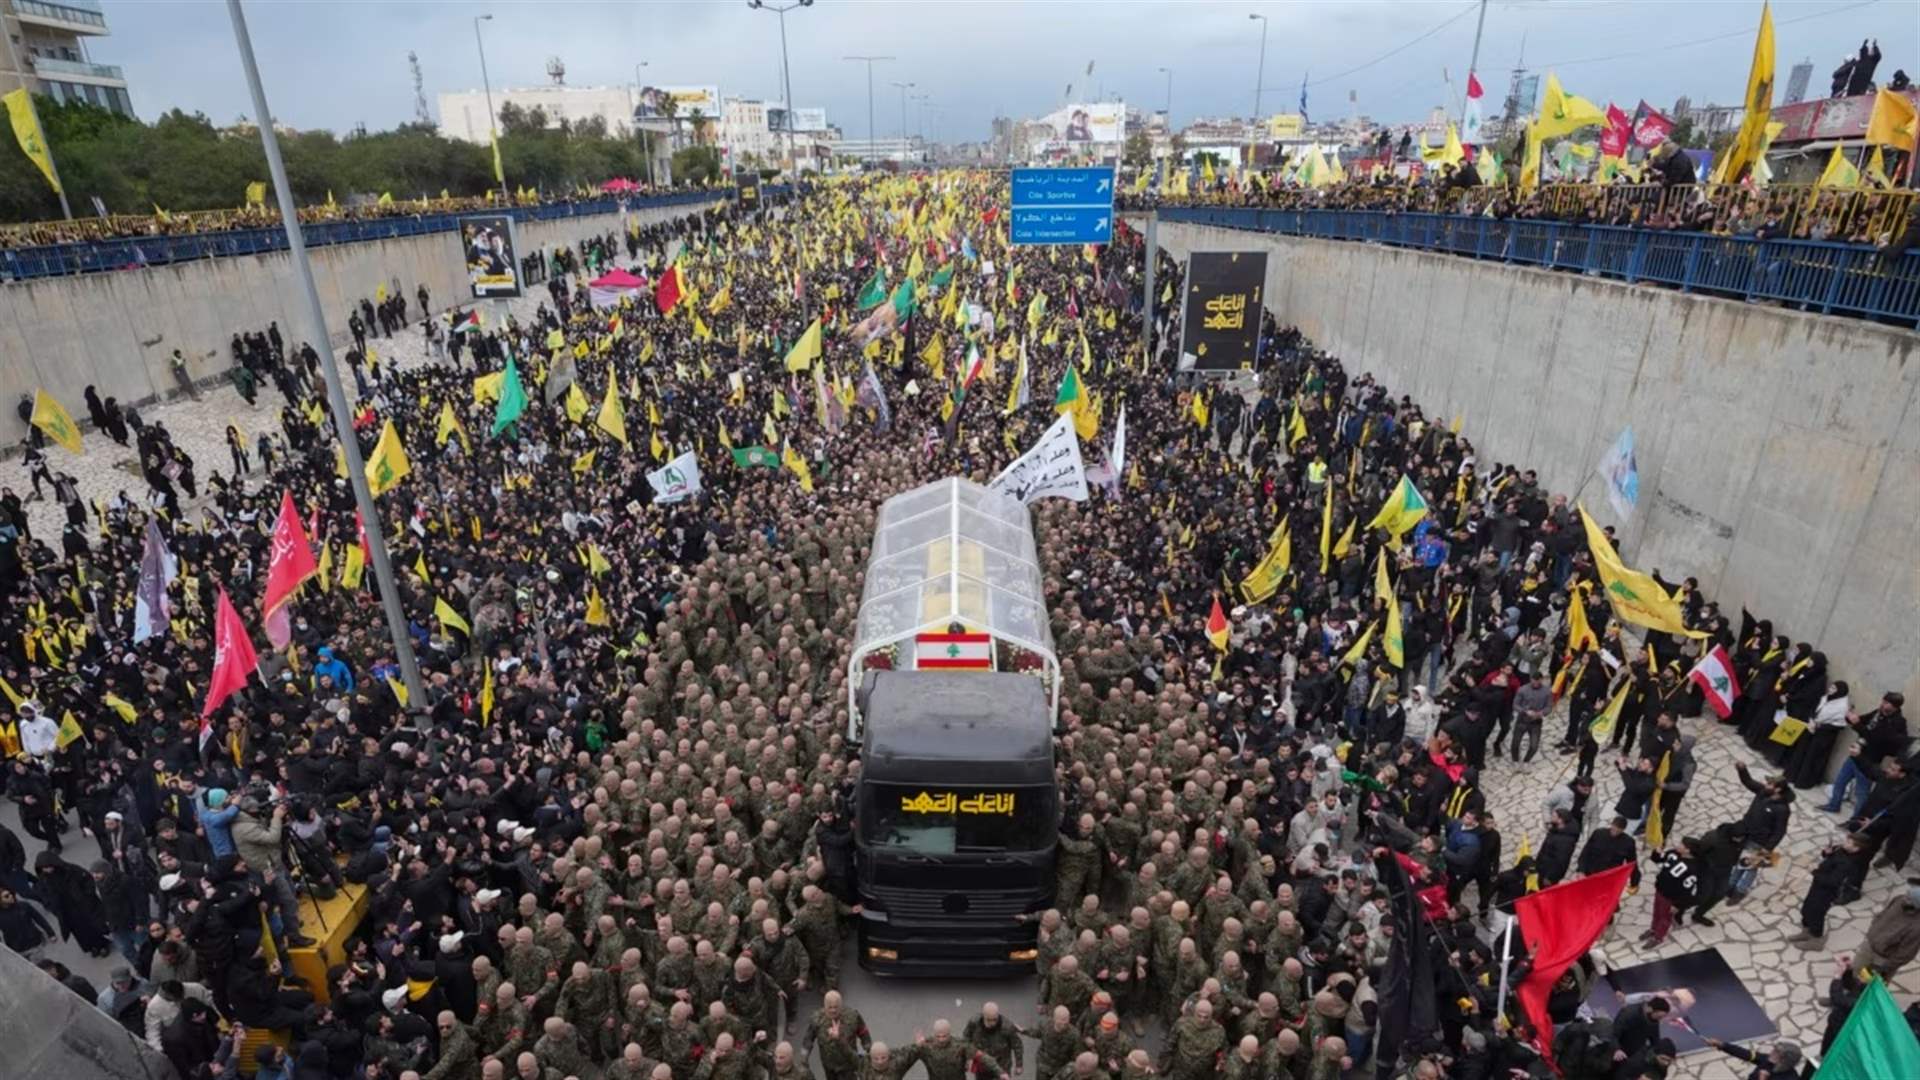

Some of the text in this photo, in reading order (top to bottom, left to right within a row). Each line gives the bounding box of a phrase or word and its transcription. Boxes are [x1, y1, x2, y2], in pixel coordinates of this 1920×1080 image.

[1016, 173, 1089, 184] المدينة الرياضية
[1047, 191, 1076, 200] Sportive
[1015, 212, 1076, 224] تقاطع الكولا
[1203, 311, 1244, 330] العهد
[902, 792, 957, 814] العهد
[959, 793, 996, 814] على
